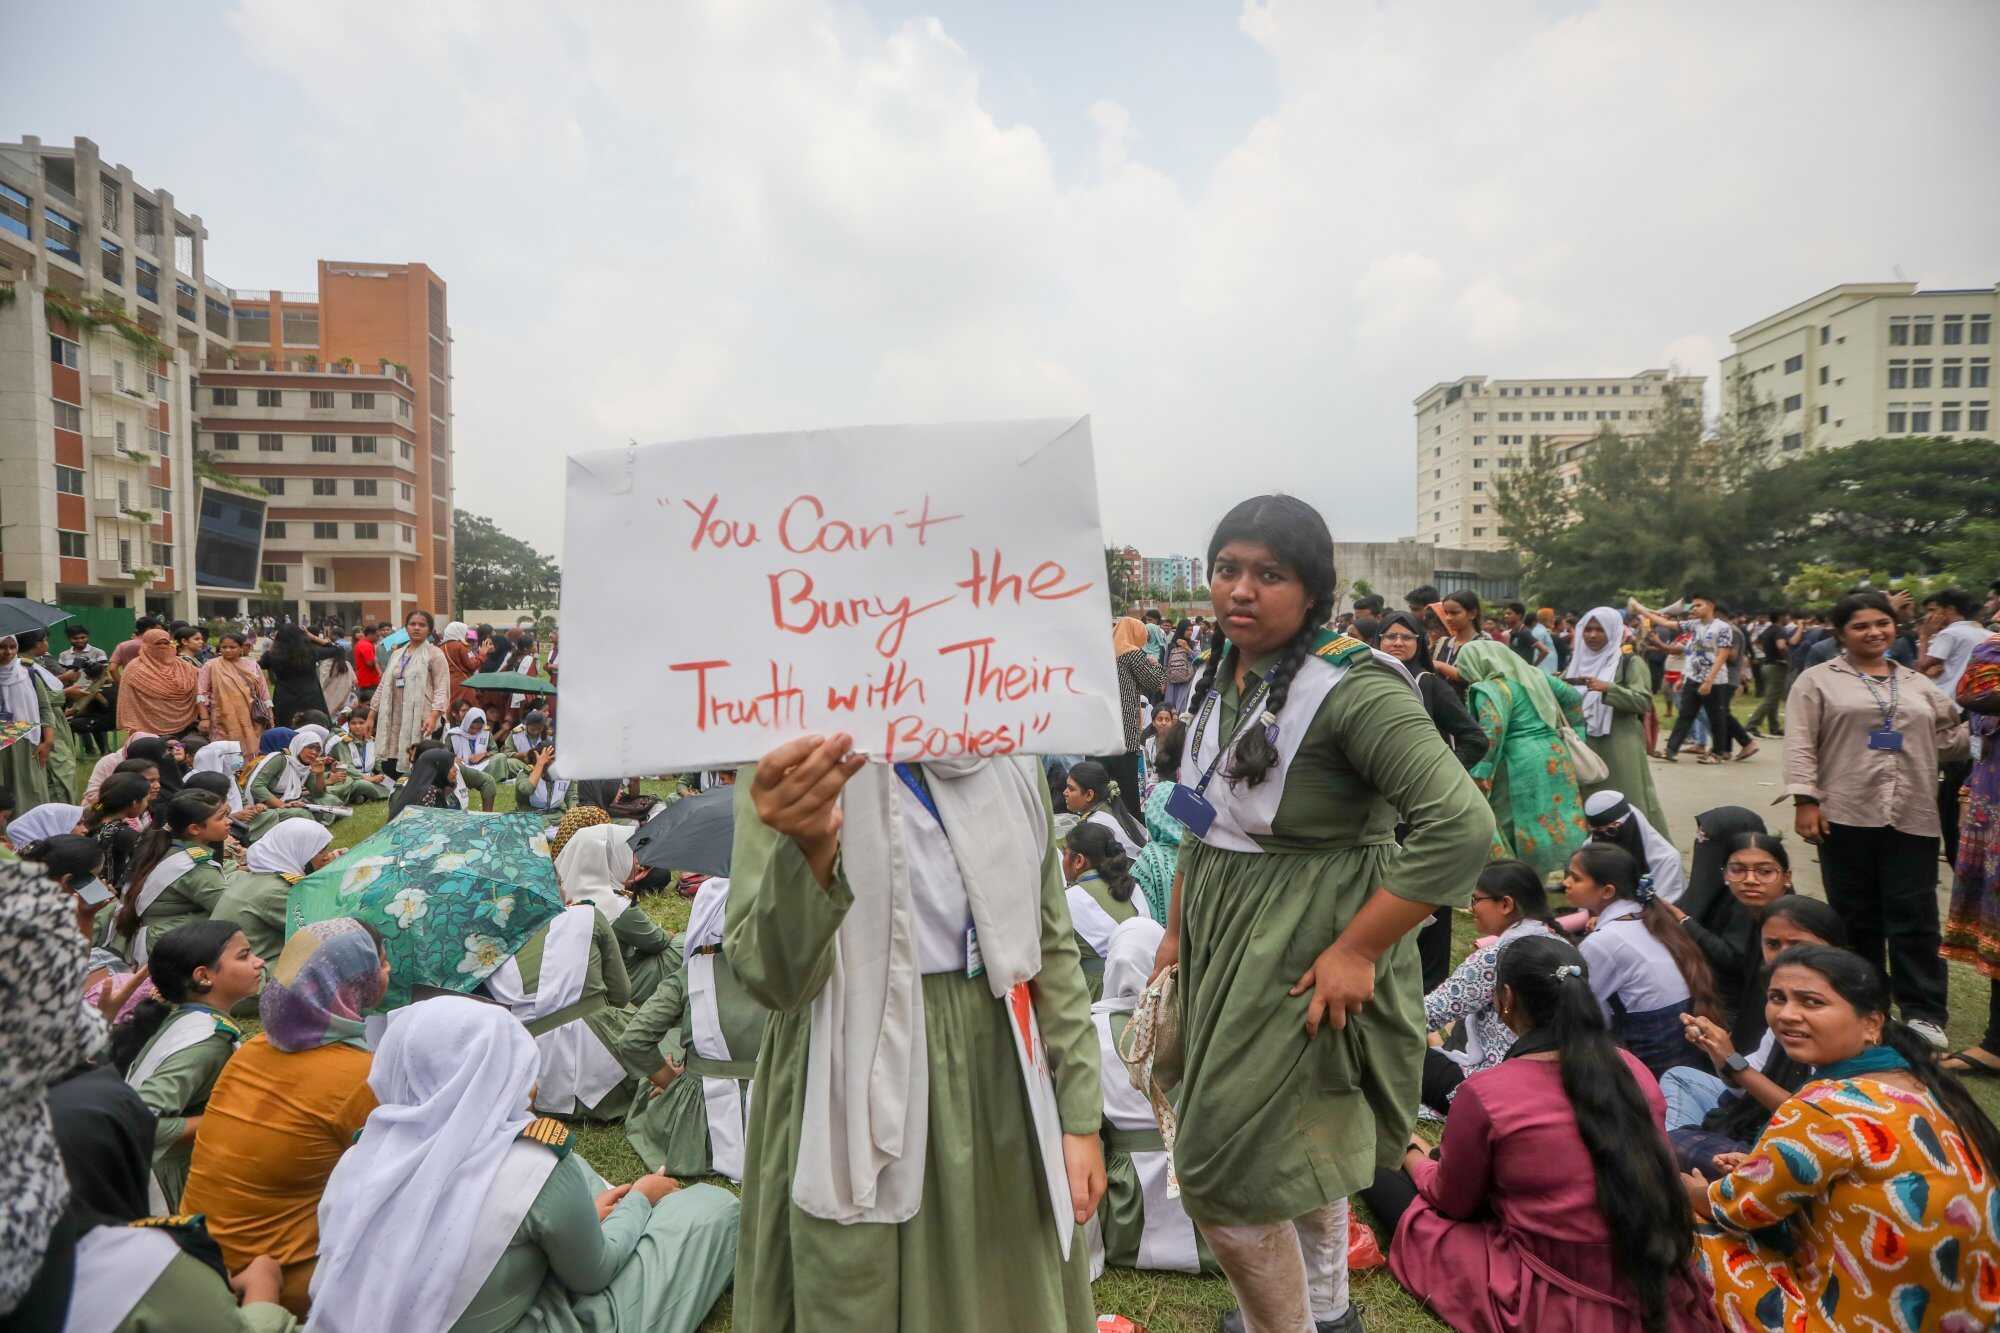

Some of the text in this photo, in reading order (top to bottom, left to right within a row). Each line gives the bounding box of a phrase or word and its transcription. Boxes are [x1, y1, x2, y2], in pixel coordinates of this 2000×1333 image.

[768, 546, 1095, 660] Bury the
[668, 636, 1085, 732] Truth with Their
